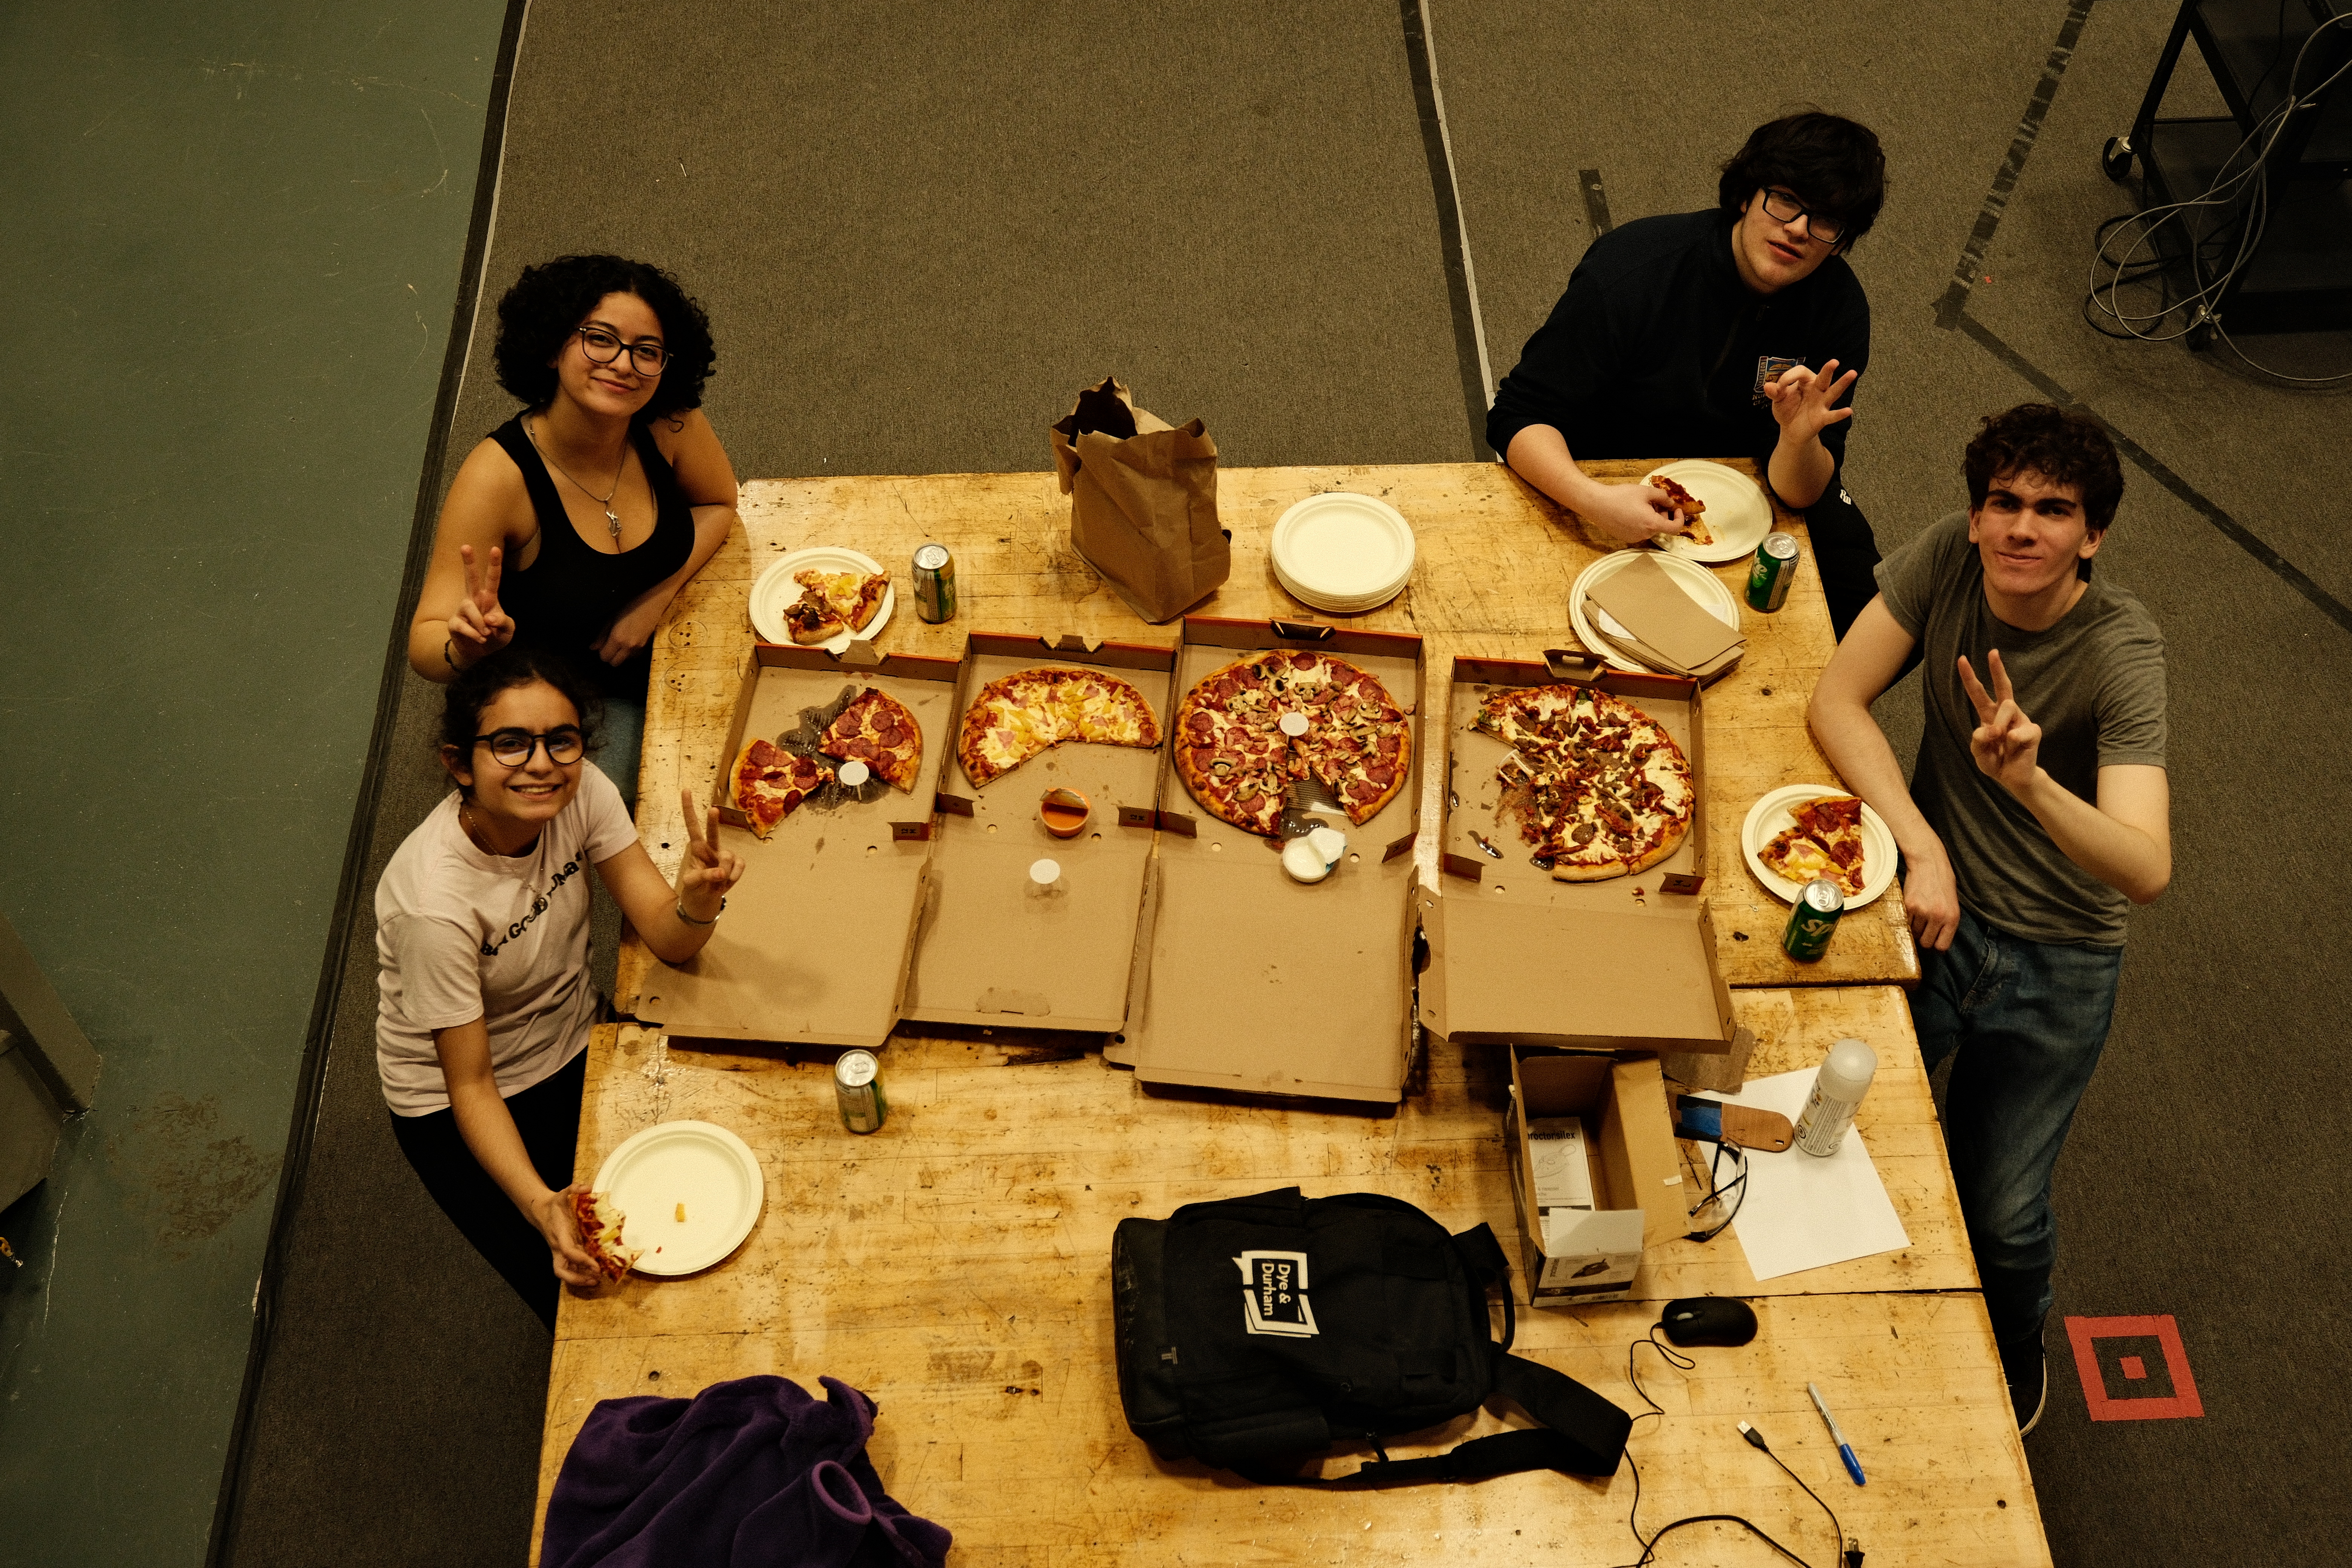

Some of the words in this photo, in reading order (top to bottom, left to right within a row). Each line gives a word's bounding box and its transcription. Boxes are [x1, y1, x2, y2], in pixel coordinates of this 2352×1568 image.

[1262, 1263, 1277, 1316] Durham
[1276, 1263, 1291, 1291] Dye
[1279, 1294, 1291, 1305] &
